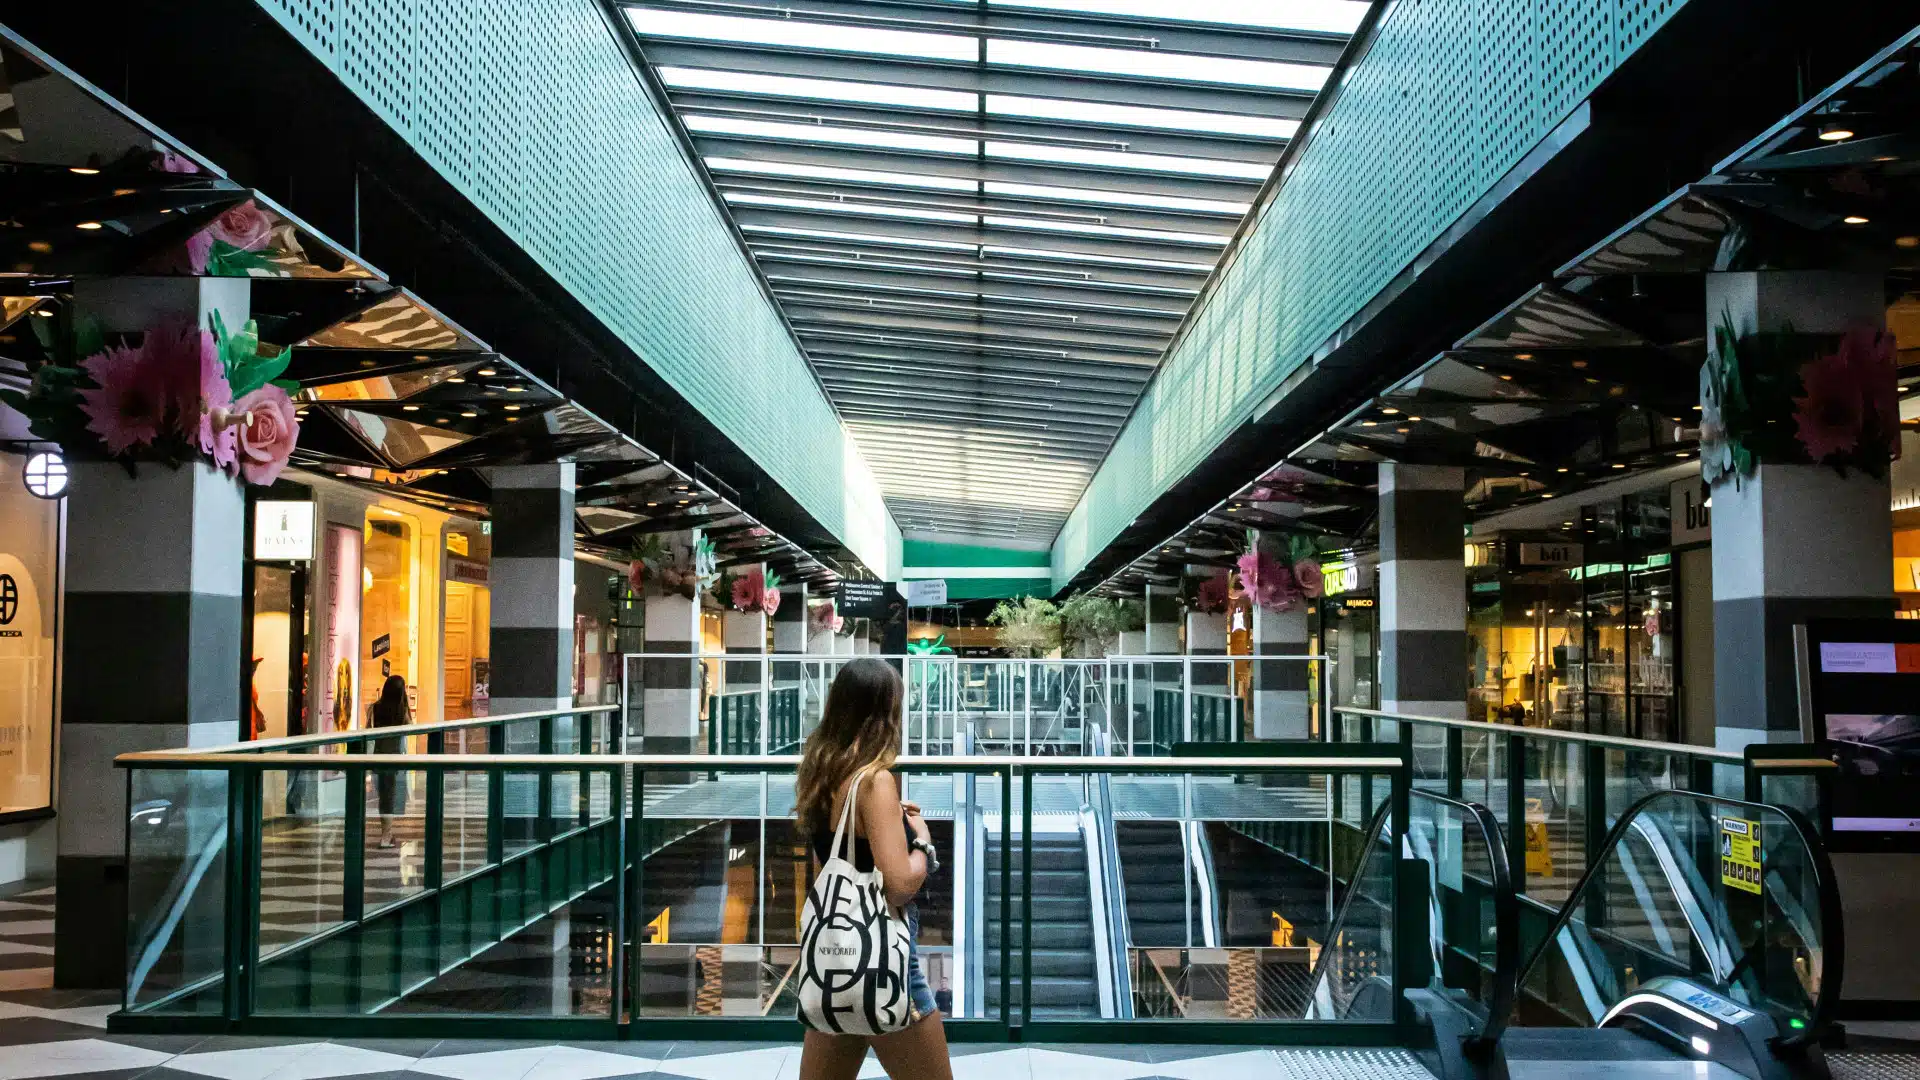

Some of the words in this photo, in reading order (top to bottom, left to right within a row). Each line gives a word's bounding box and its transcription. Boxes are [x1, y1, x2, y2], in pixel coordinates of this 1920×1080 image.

[264, 535, 304, 545] RAIN
[1346, 599, 1373, 607] MIMCO
[1724, 820, 1746, 833] WARNING
[808, 873, 888, 931] NEW
[819, 946, 832, 956] NEW
[832, 946, 857, 956] YORKER
